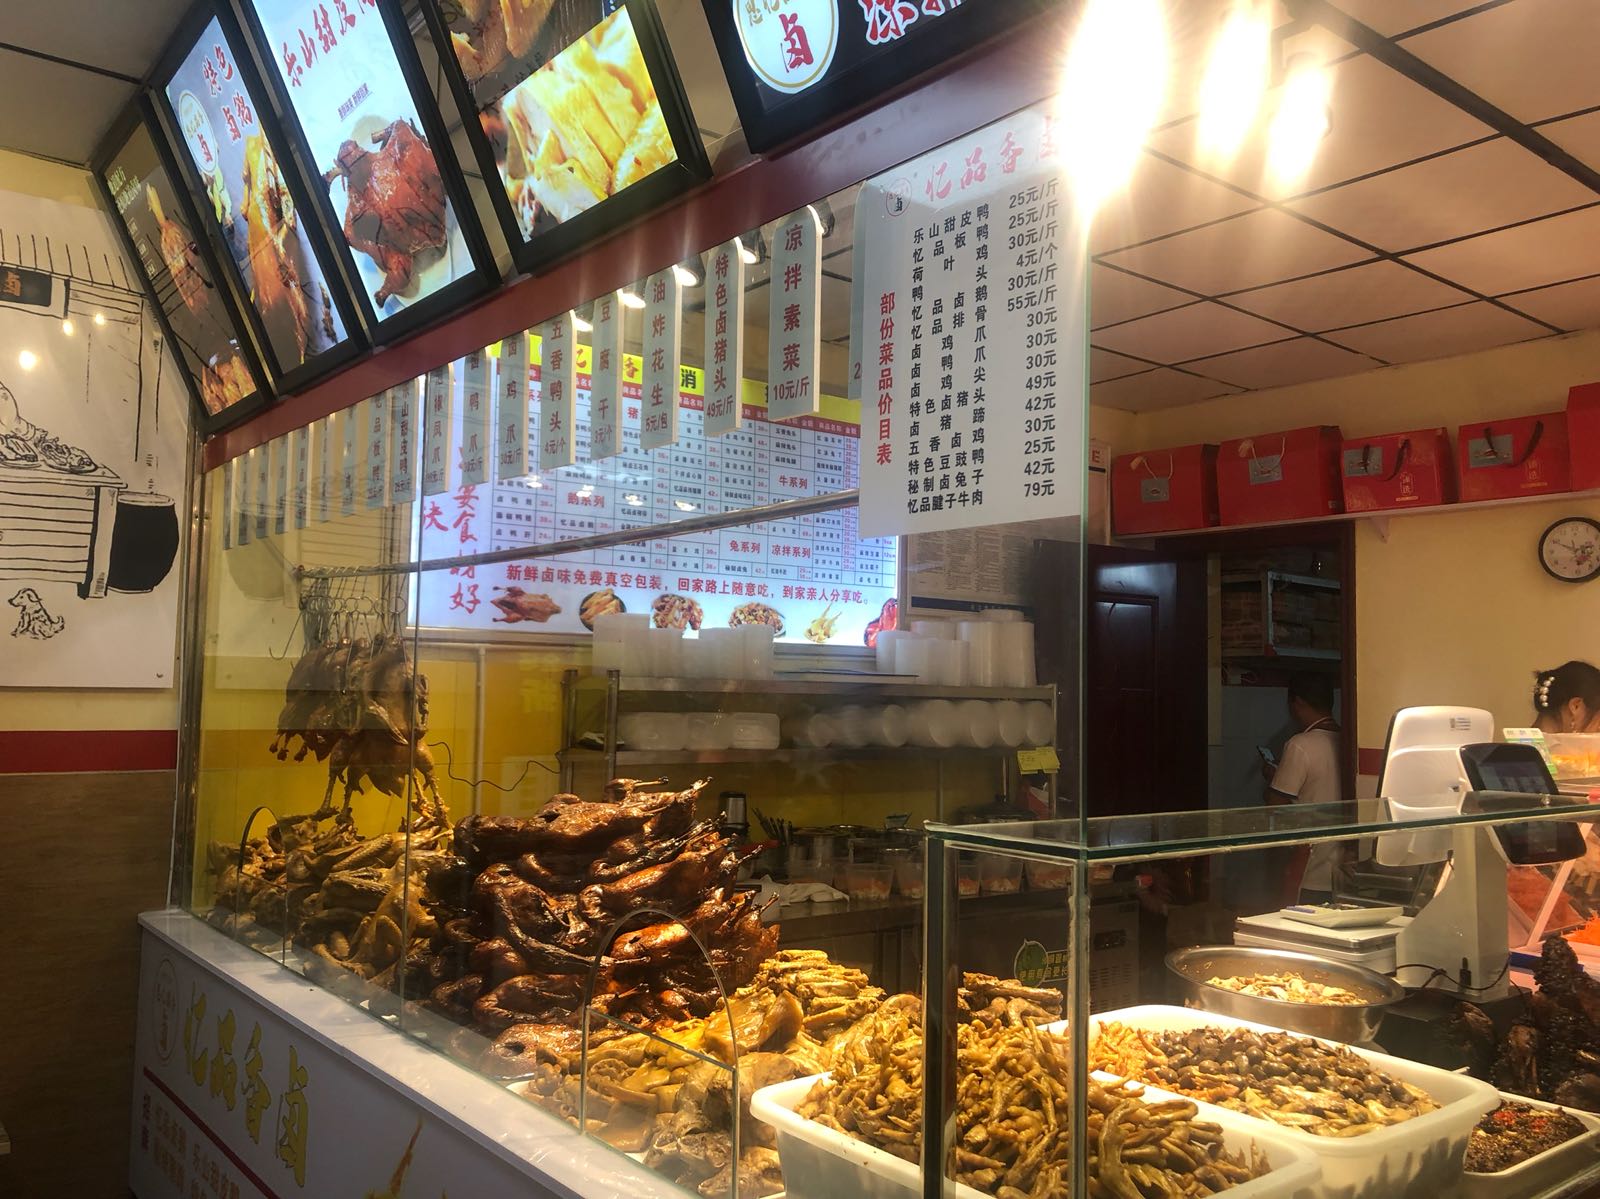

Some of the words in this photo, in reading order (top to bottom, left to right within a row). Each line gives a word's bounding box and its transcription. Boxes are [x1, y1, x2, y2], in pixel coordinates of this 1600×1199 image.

[283, 0, 376, 88] 乐山甜皮
[912, 203, 990, 245] 乐山甜皮鸭
[1009, 178, 1059, 209] 25元/斤
[912, 223, 990, 264] 忆品板鸭
[1009, 199, 1059, 229] 25元/斤
[912, 245, 989, 283] 荷叶鸡
[1008, 221, 1059, 250] 30元/斤
[1016, 242, 1059, 268] 4元/个
[783, 223, 804, 372] 凉拌素菜
[911, 285, 988, 322] 忆品卤鹅
[1008, 263, 1058, 292] 30元/斤
[911, 305, 987, 341] 忆品排骨
[1007, 284, 1058, 312] 55元/斤
[650, 279, 666, 408] 油炸花生
[714, 254, 729, 394] 特色卤猪头
[911, 325, 987, 359] 卤鸡爪
[1026, 306, 1058, 328] 30元
[549, 320, 564, 433] 五香鸭头
[910, 346, 986, 379] 卤鸭爪
[1026, 328, 1057, 349] 30元
[910, 366, 986, 398] 卤鸡尖
[1025, 349, 1057, 370] 30元
[680, 368, 698, 390] 消
[773, 375, 811, 402] 10元/斤
[876, 291, 896, 467] 部份菜品价目表
[909, 387, 986, 418] 特色卤猪头
[1025, 371, 1056, 391] 49元
[706, 396, 734, 419] 49元/斤
[909, 407, 985, 437] 卤猪蹄
[1025, 392, 1056, 412] 42元
[908, 427, 985, 456] 五香卤鸡
[1024, 414, 1056, 434] 30元
[908, 448, 985, 476] 特色豆豉鸭
[1024, 435, 1055, 455] 25元
[778, 475, 809, 490] 牛系列
[907, 469, 984, 495] 秘制卤兔子
[1024, 457, 1055, 476] 42元
[907, 489, 984, 515] 忆品腱子牛肉
[1023, 479, 1055, 498] 79元
[729, 540, 760, 554] 兔系列
[771, 543, 811, 559] 凉拌系列
